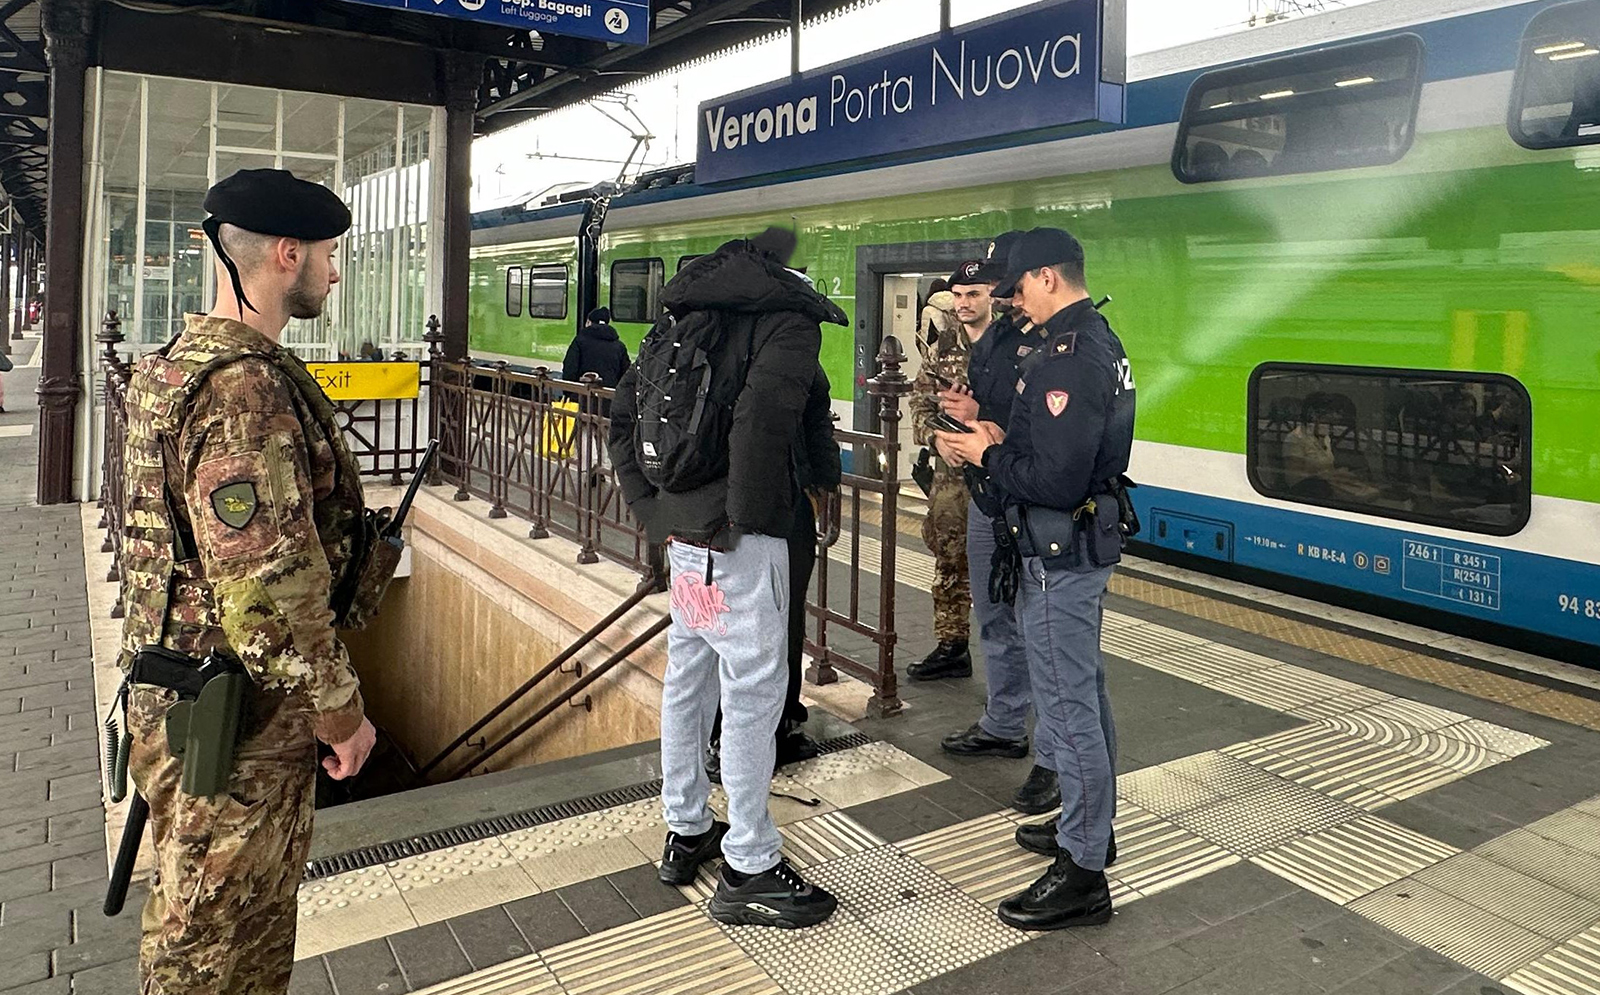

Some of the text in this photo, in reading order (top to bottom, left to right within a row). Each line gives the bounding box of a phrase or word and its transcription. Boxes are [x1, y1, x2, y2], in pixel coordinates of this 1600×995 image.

[501, 4, 558, 23] Left Luggage
[539, 0, 591, 18] Bagagli
[705, 32, 1082, 153] Verona Porta Nuova
[832, 276, 841, 295] 2
[1297, 543, 1305, 556] R
[1308, 545, 1347, 565] KB R-E-A
[1408, 543, 1430, 559] 246
[1453, 552, 1461, 565] R
[1462, 554, 1480, 568] 345
[1469, 589, 1484, 604] 131
[1558, 594, 1580, 615] 94
